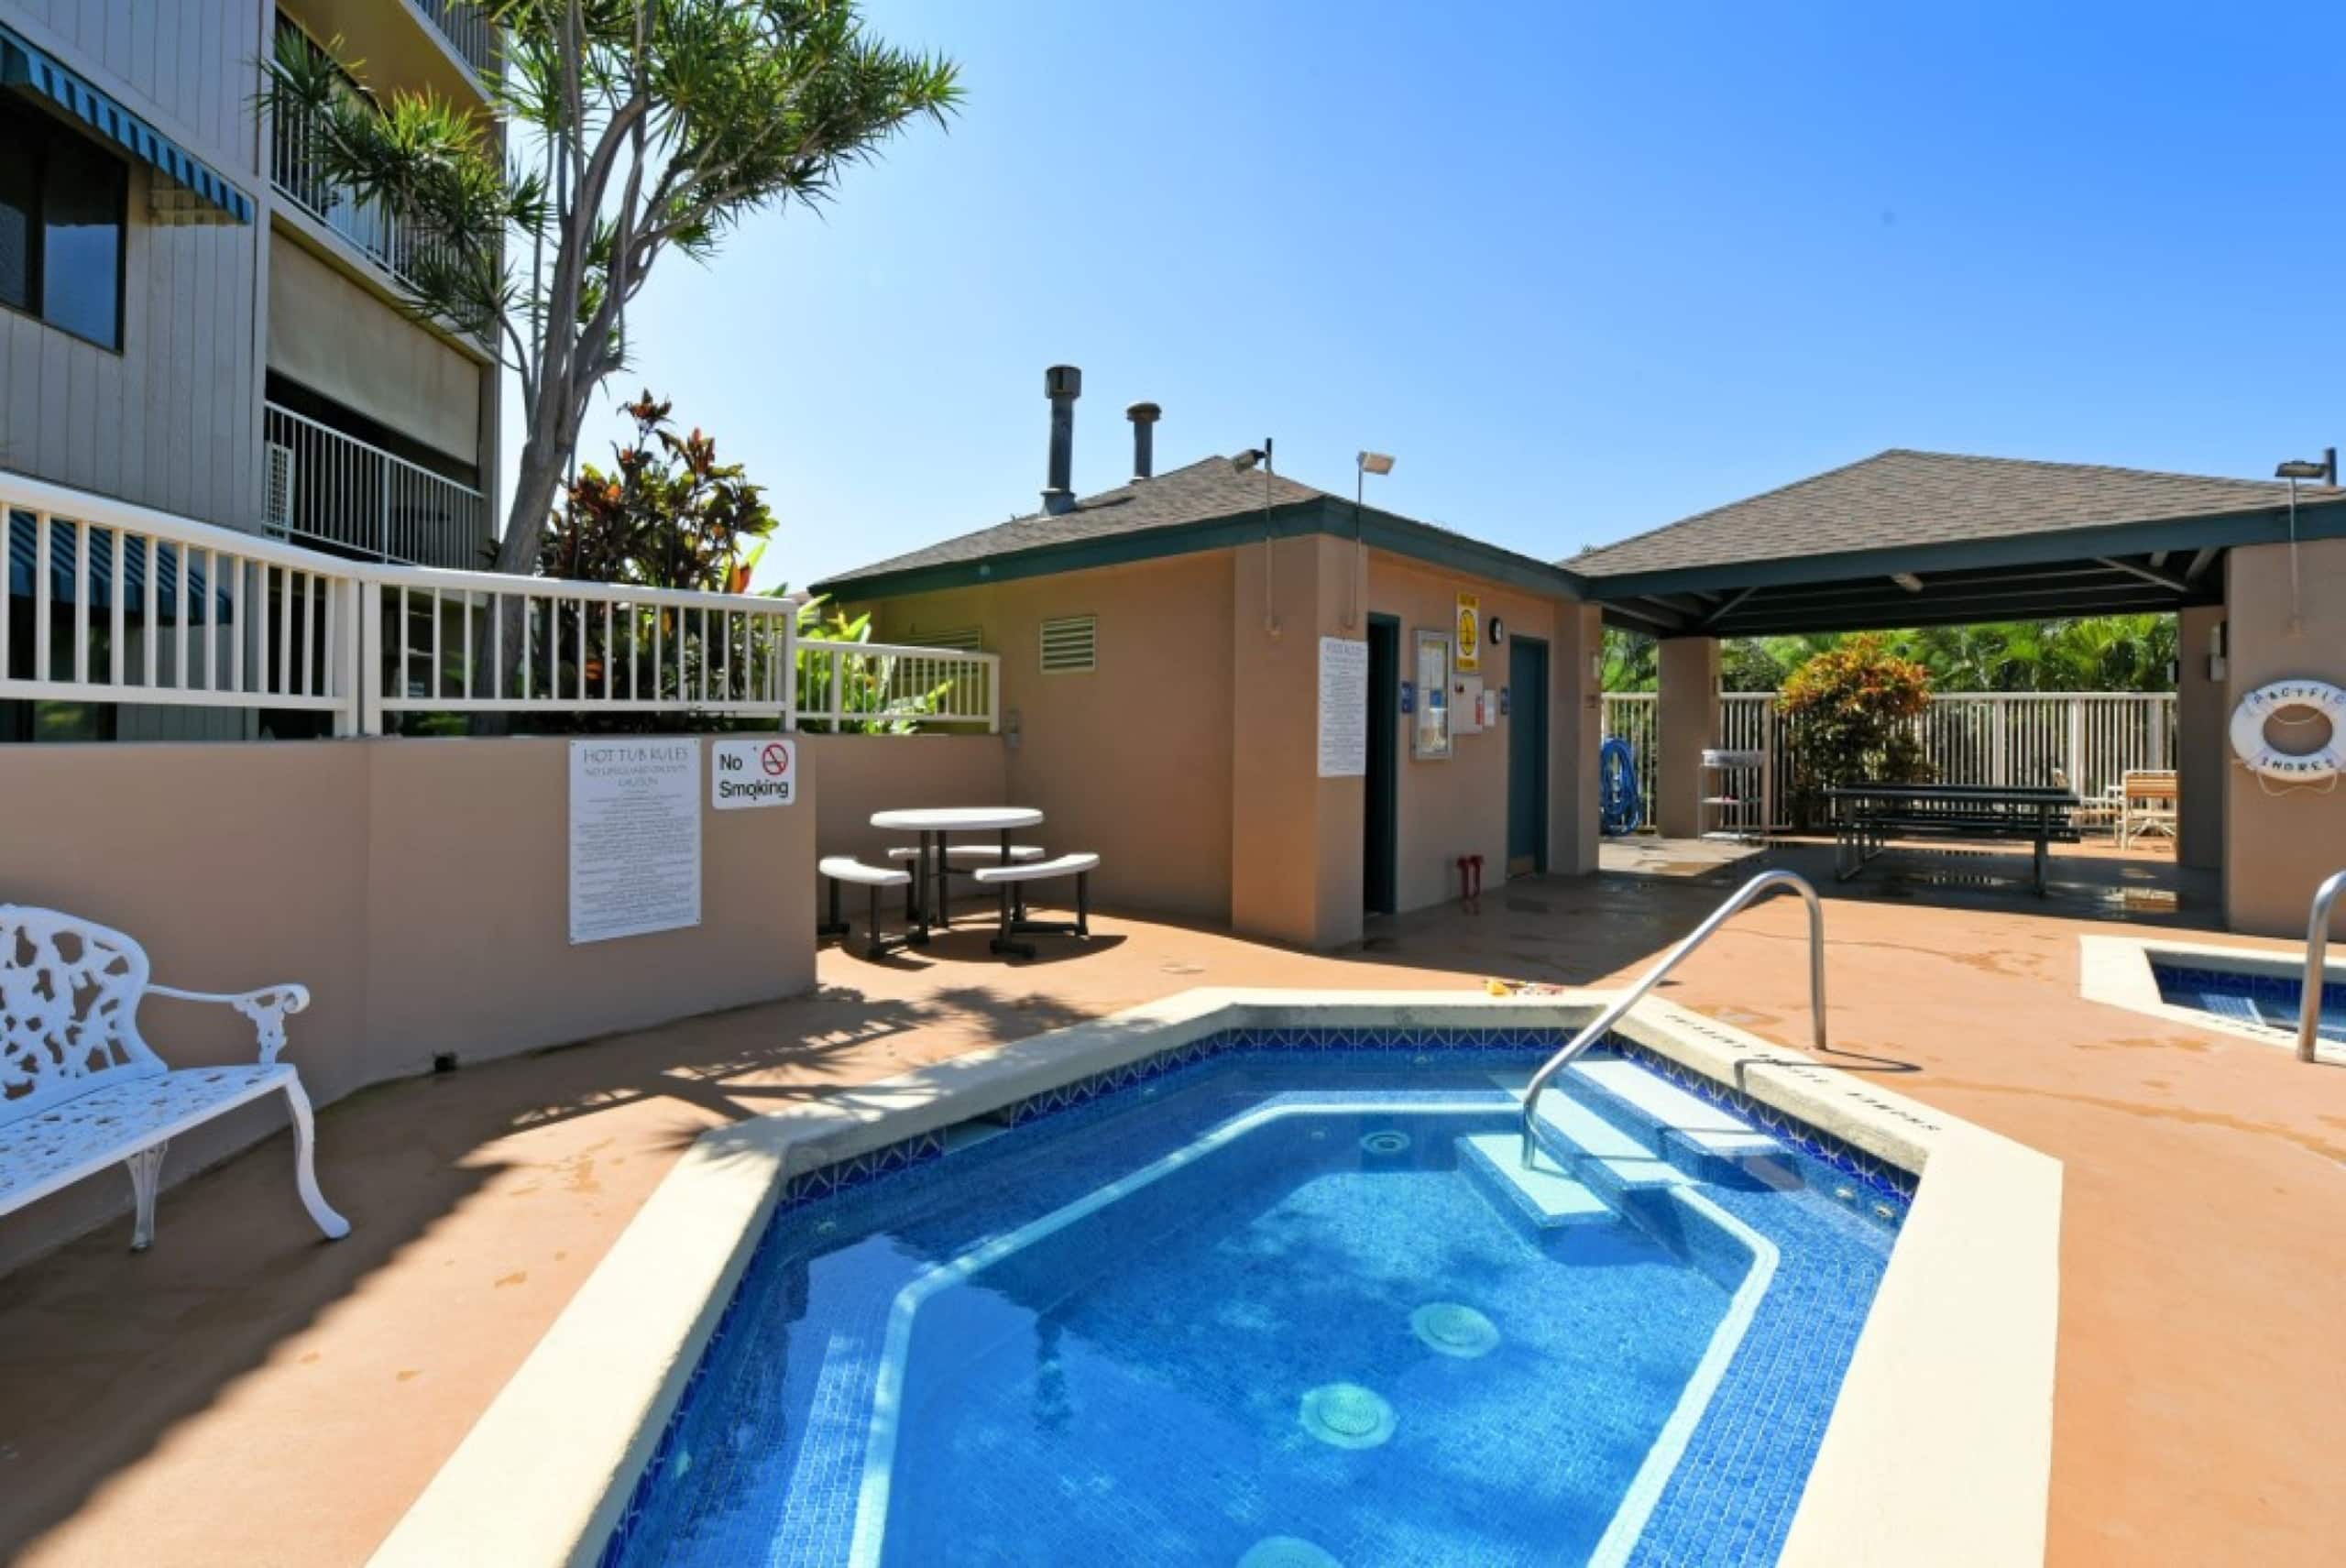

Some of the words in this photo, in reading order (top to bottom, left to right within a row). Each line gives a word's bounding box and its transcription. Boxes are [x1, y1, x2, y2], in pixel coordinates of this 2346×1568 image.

[584, 748, 614, 763] HOT
[616, 748, 647, 762] TUB
[651, 747, 689, 762] RULES
[719, 753, 743, 771] No
[718, 779, 789, 799] Smoking
